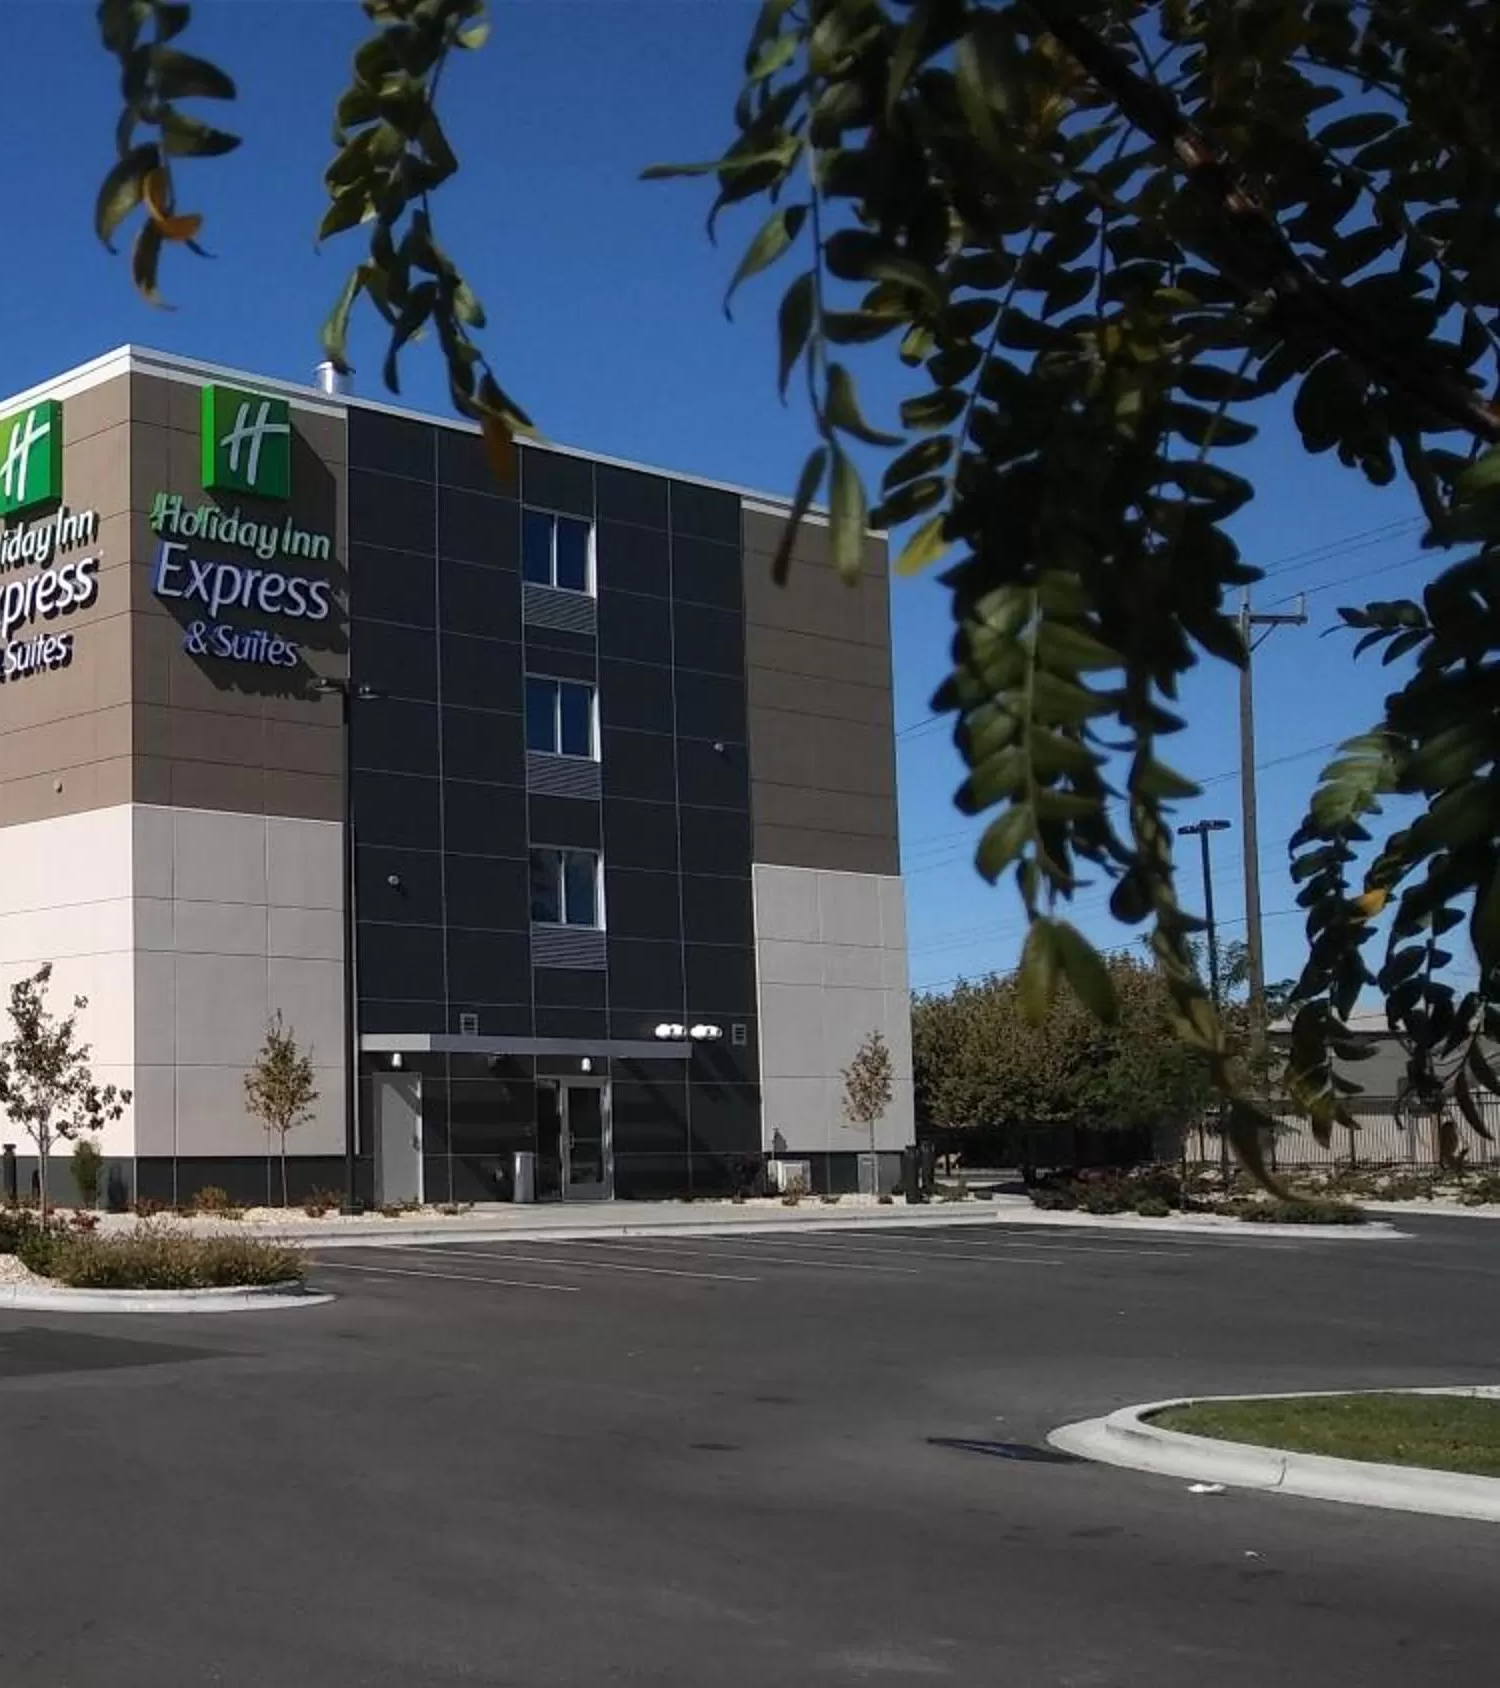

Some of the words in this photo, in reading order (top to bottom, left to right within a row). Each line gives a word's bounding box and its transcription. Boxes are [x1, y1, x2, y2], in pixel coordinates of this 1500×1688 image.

[56, 505, 93, 546] Inn
[152, 493, 278, 560] Holiday
[282, 516, 331, 560] Inn
[155, 541, 331, 620] Express
[4, 633, 68, 673] Suites
[186, 621, 208, 654] &
[212, 624, 300, 667] Suites
